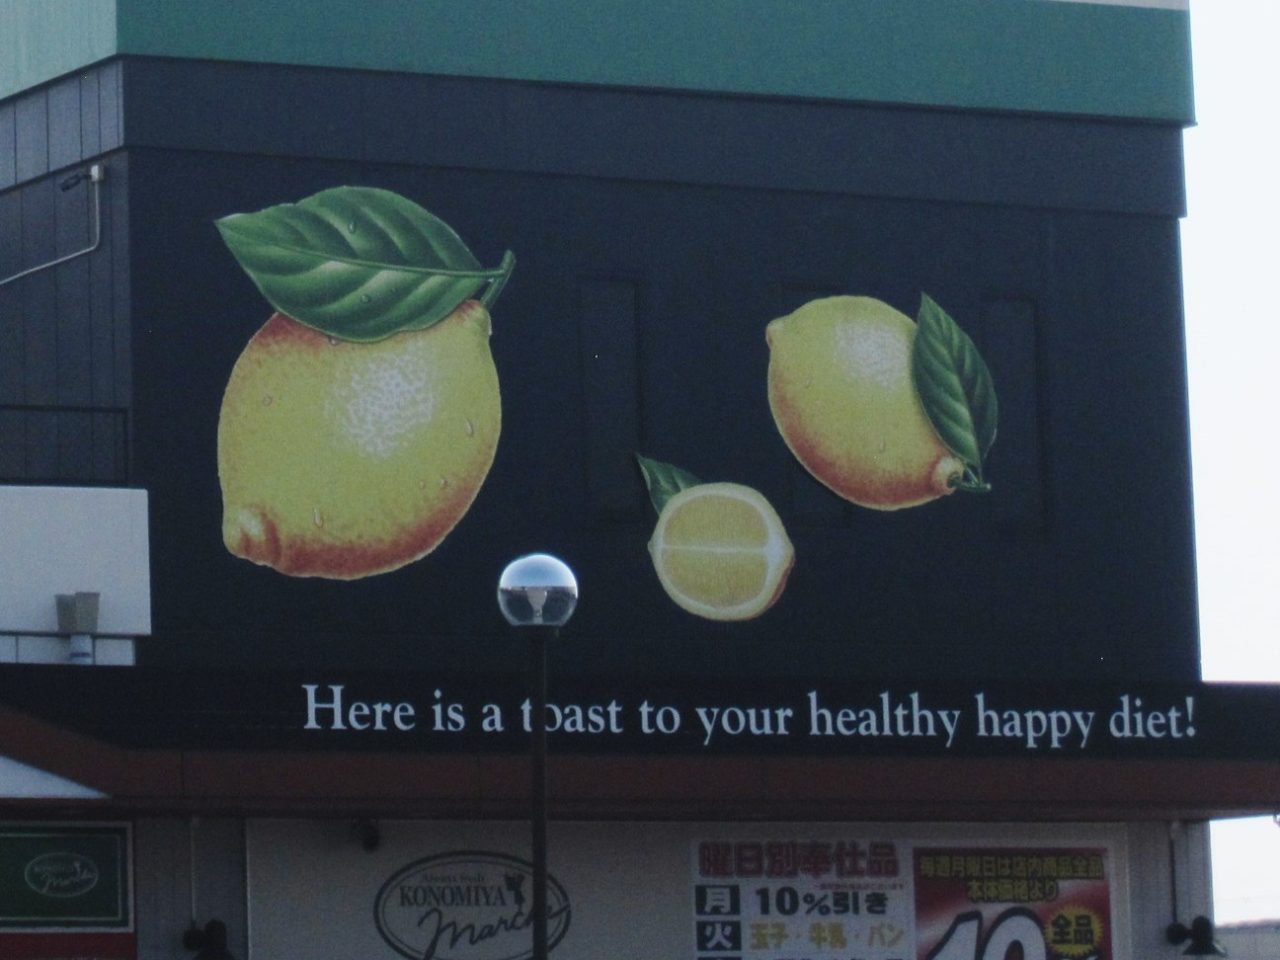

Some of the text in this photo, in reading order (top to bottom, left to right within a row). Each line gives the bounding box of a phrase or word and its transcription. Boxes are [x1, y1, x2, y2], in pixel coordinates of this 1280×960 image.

[301, 684, 416, 731] Here
[431, 689, 465, 732] is
[482, 703, 504, 732] a
[638, 699, 681, 734] to
[695, 705, 793, 746] your
[807, 690, 961, 748] healthy
[975, 692, 1095, 749] happy
[1109, 693, 1197, 738] diet!
[399, 885, 507, 907] KONOMIYA
[704, 886, 732, 915] 月
[704, 923, 733, 950] 火
[1051, 914, 1095, 945] 全品
